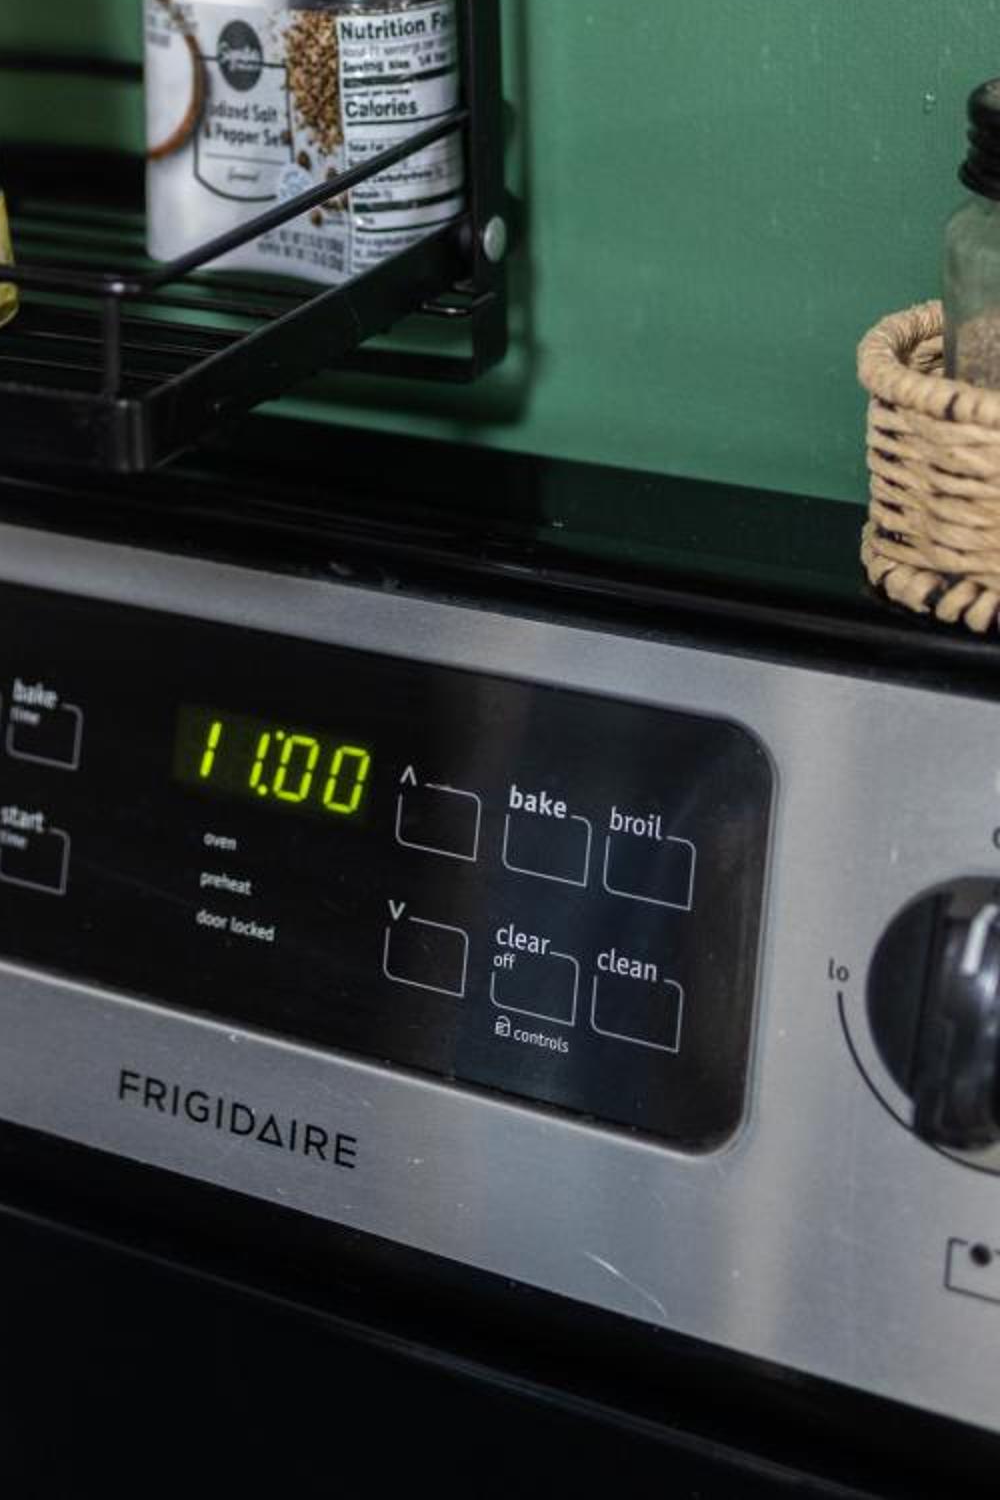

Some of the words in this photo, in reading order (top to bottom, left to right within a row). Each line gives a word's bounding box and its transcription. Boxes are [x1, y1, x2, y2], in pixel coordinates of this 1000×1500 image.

[341, 17, 426, 40] Nutrition
[206, 102, 249, 120] odized
[345, 99, 418, 118] Calories
[12, 679, 58, 709] bake
[200, 721, 371, 813] 11:00
[509, 785, 567, 819] bake
[0, 806, 45, 833] start
[609, 806, 663, 841] broil
[203, 833, 237, 850] oven
[200, 872, 252, 895] preheat
[196, 909, 228, 930] door
[230, 916, 275, 941] locked
[496, 924, 550, 955] clear
[493, 953, 516, 970] off
[597, 948, 658, 983] clean
[828, 959, 849, 981] lo
[513, 1028, 569, 1053] controls
[119, 1070, 357, 1169] FRIGIDAIRE
